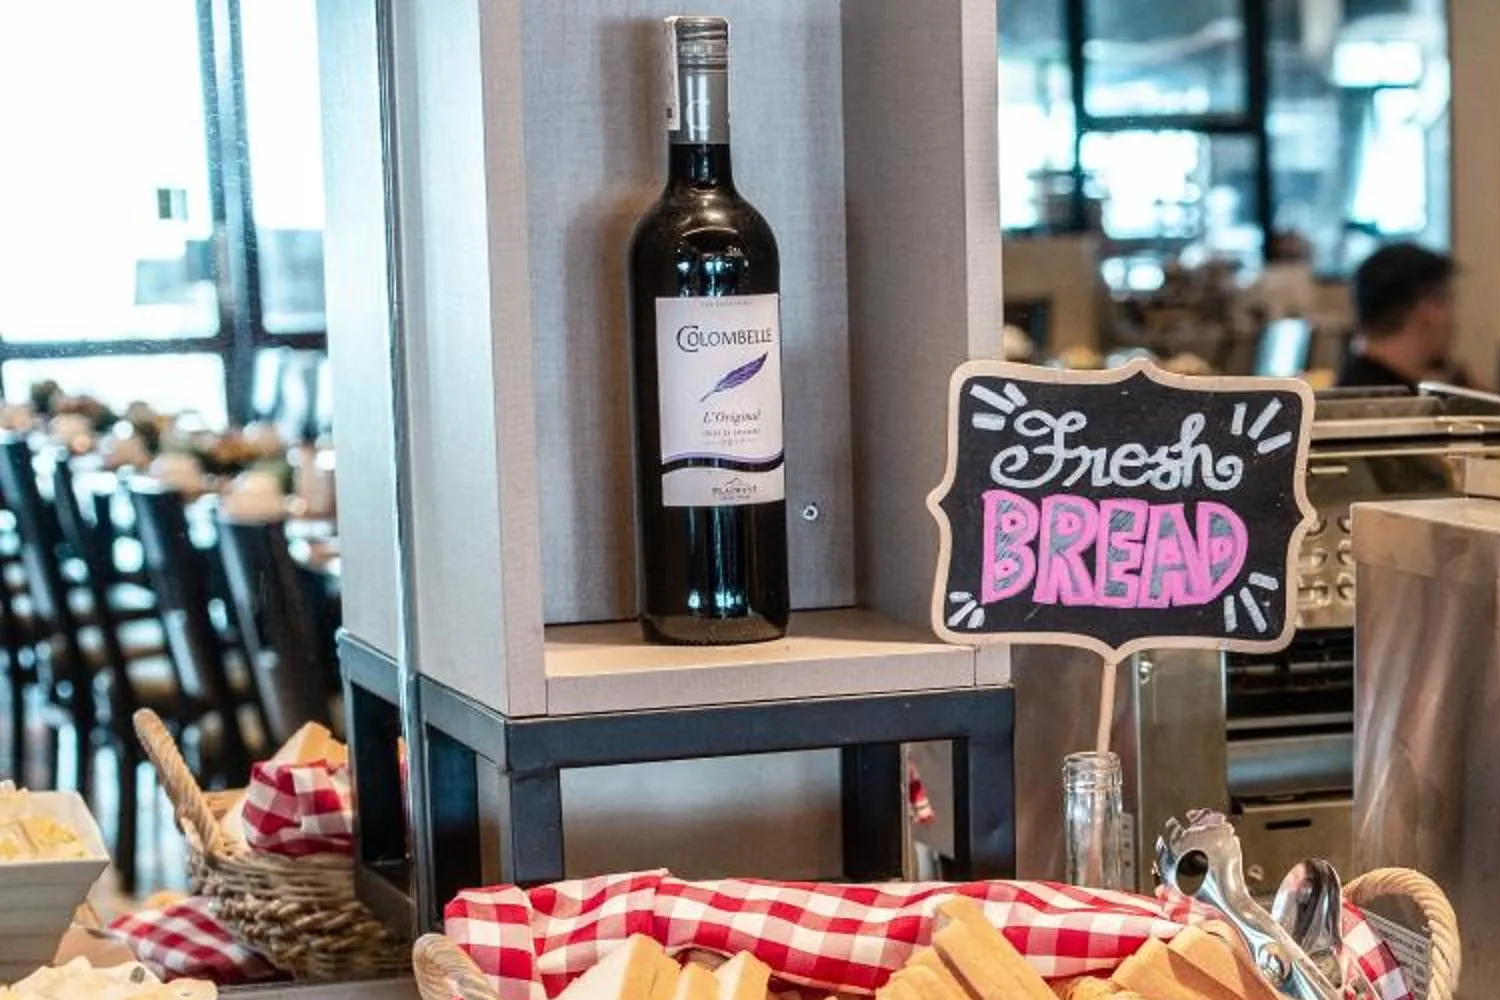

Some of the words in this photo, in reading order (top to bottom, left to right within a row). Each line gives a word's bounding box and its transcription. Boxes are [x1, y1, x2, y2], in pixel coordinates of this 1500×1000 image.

[676, 325, 773, 353] COLOMBELLE
[703, 408, 761, 426] L'Original
[990, 409, 1243, 491] Fresh
[981, 489, 1249, 608] BREAD
